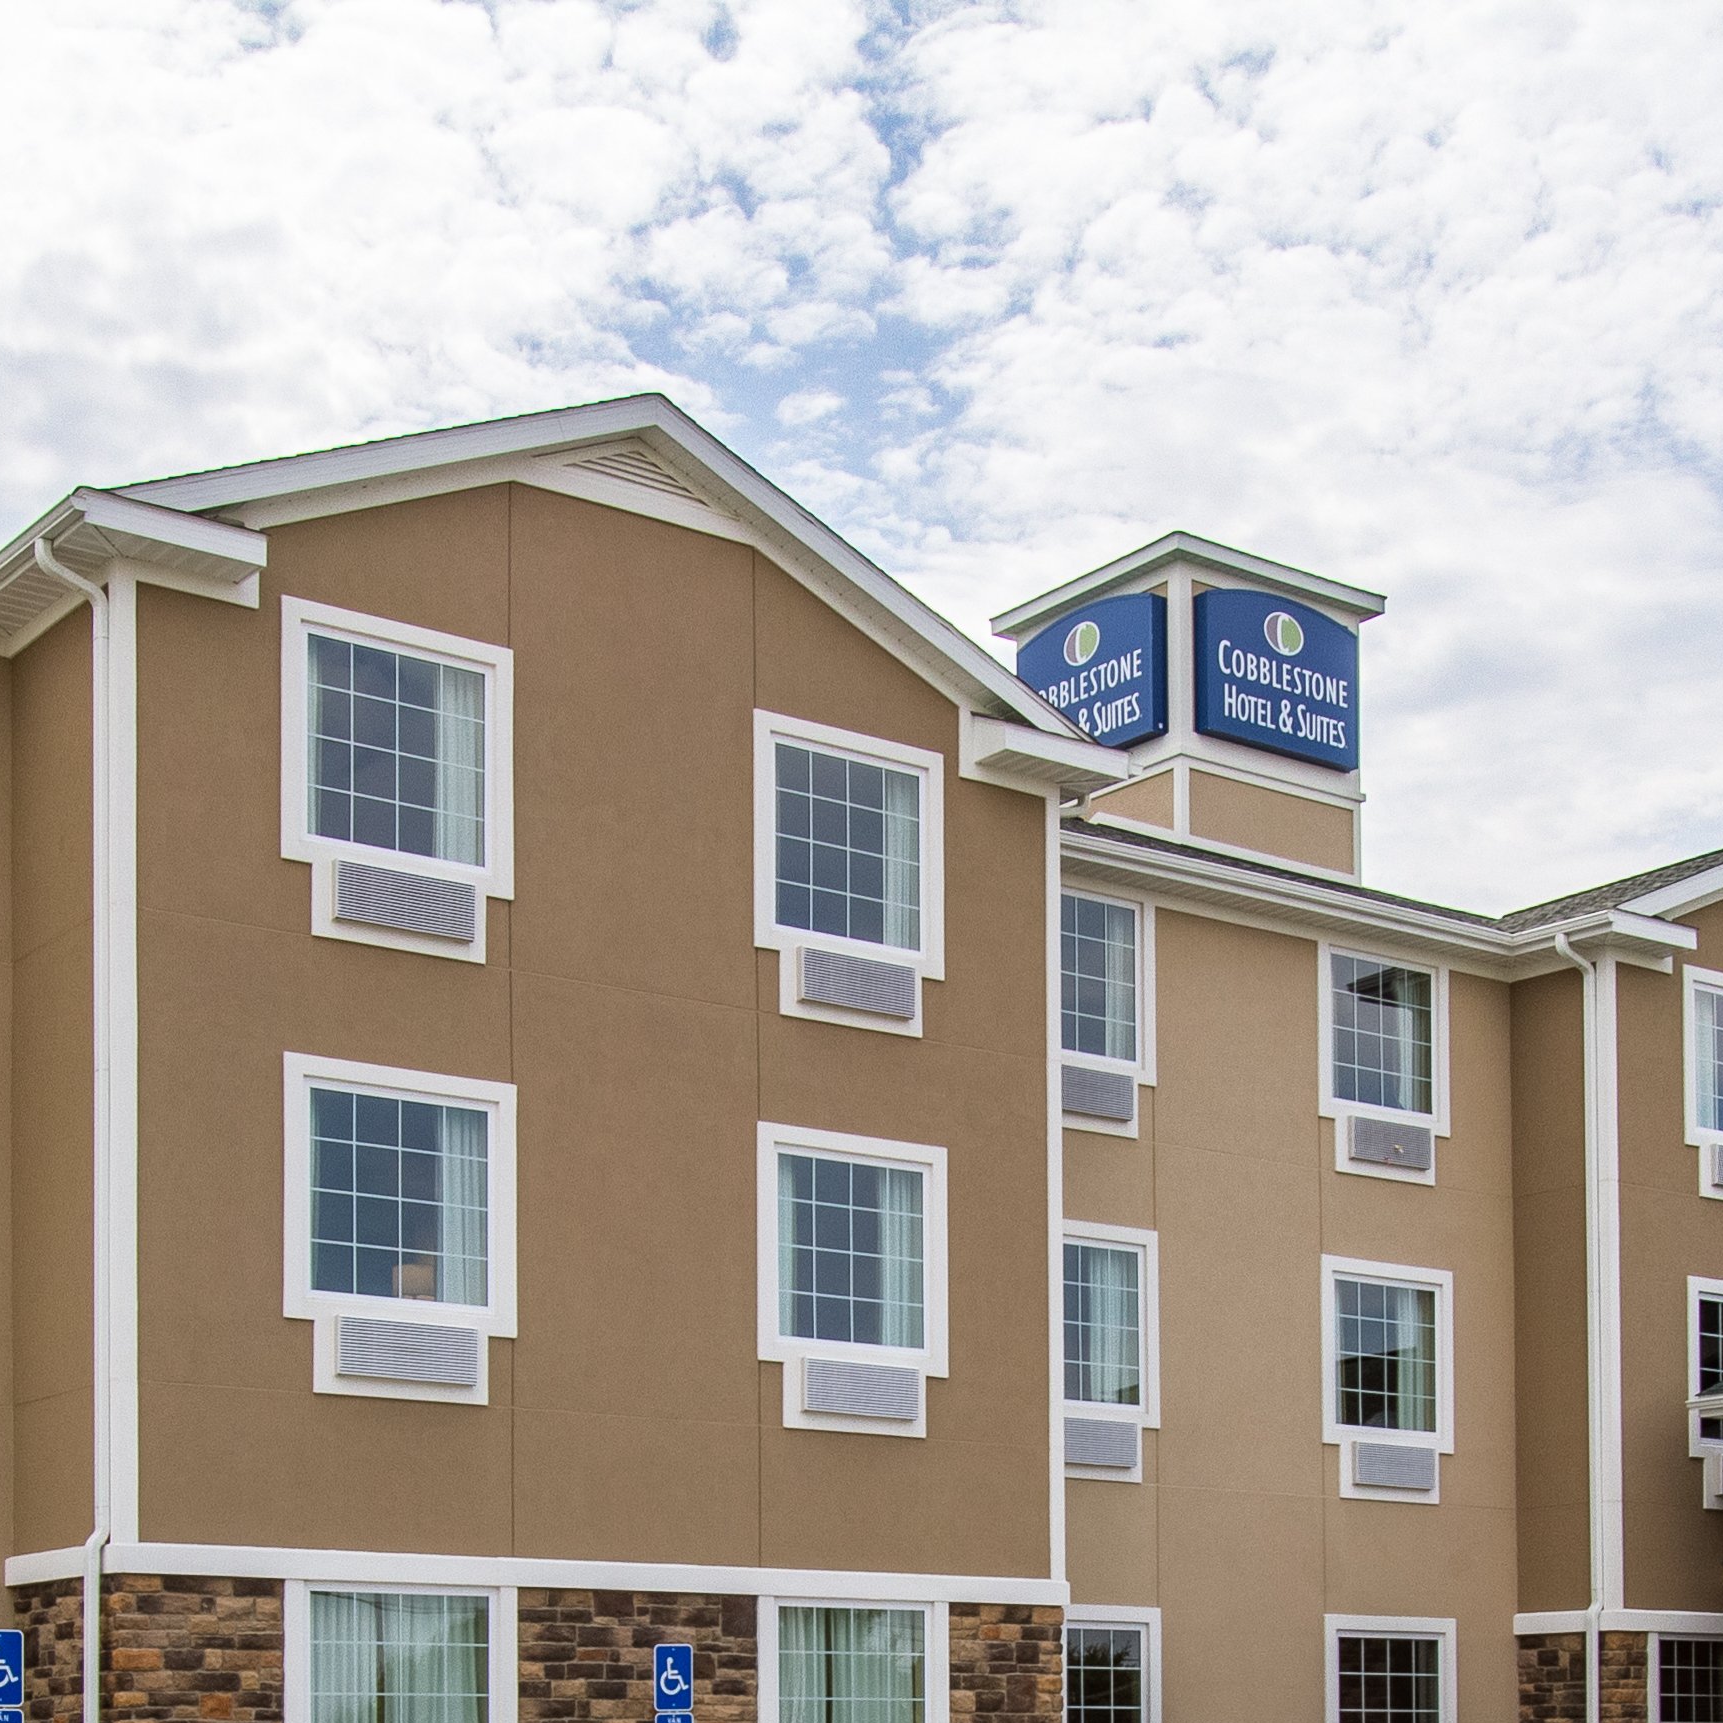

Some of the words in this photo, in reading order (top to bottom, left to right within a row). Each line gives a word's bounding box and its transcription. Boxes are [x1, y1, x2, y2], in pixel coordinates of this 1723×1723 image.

[1038, 648, 1143, 709] BBLESTONE
[1218, 639, 1349, 709] COBBLESTONE
[1092, 691, 1141, 737] SUITES
[1223, 682, 1277, 730] HOTEL
[1278, 699, 1294, 735] &
[1296, 703, 1347, 749] SUITES
